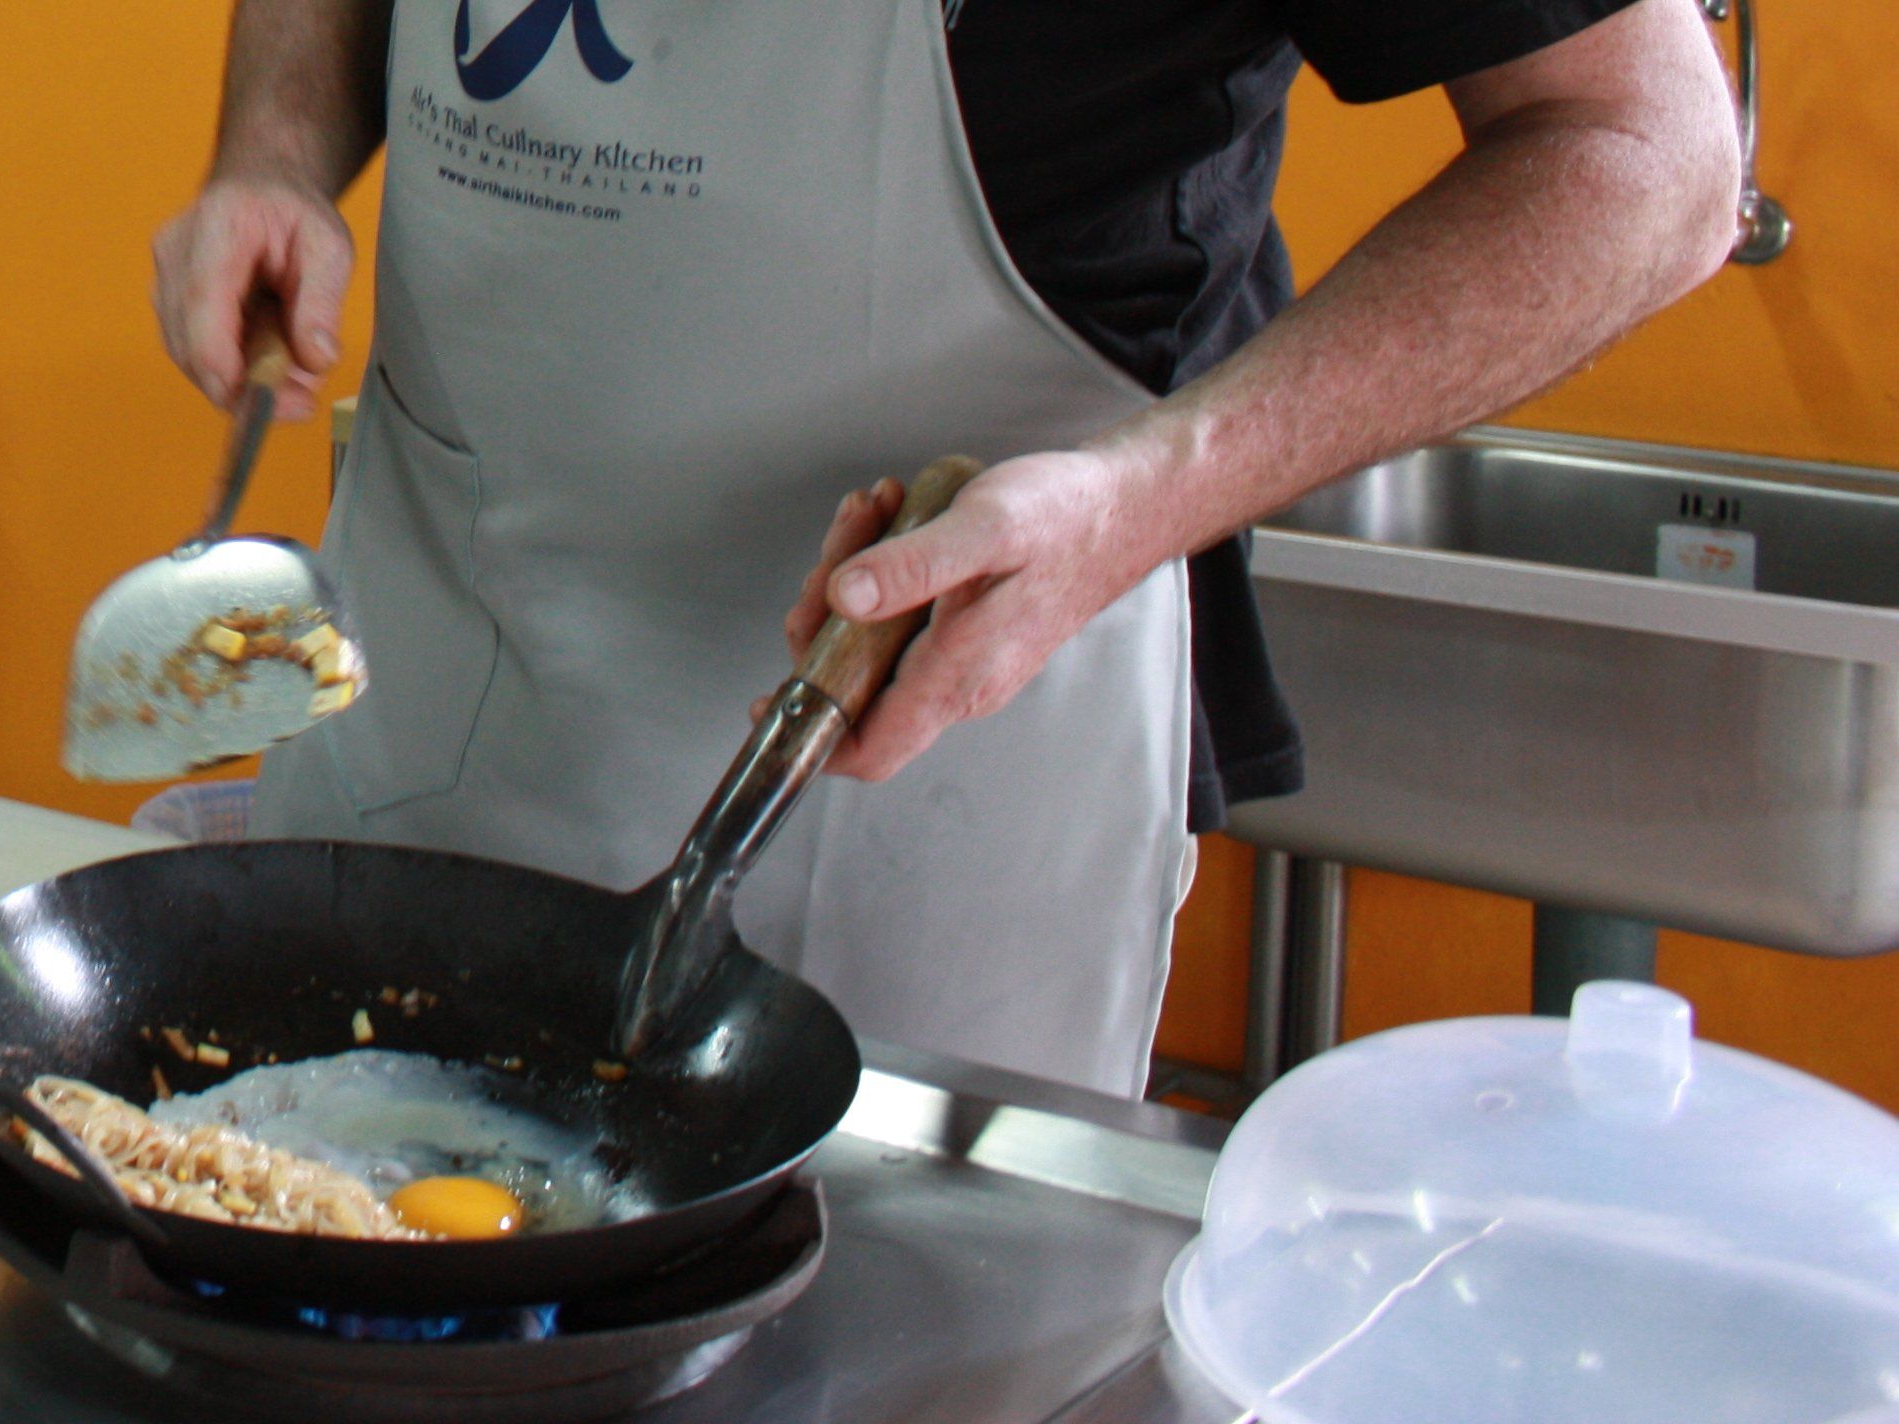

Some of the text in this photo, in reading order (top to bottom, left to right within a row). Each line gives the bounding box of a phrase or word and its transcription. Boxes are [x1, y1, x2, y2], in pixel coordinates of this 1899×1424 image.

[445, 106, 477, 140] Thai
[487, 125, 582, 167] Culinary
[595, 140, 703, 174] Kitchen
[438, 166, 621, 221] www.airthaikitchen.com
